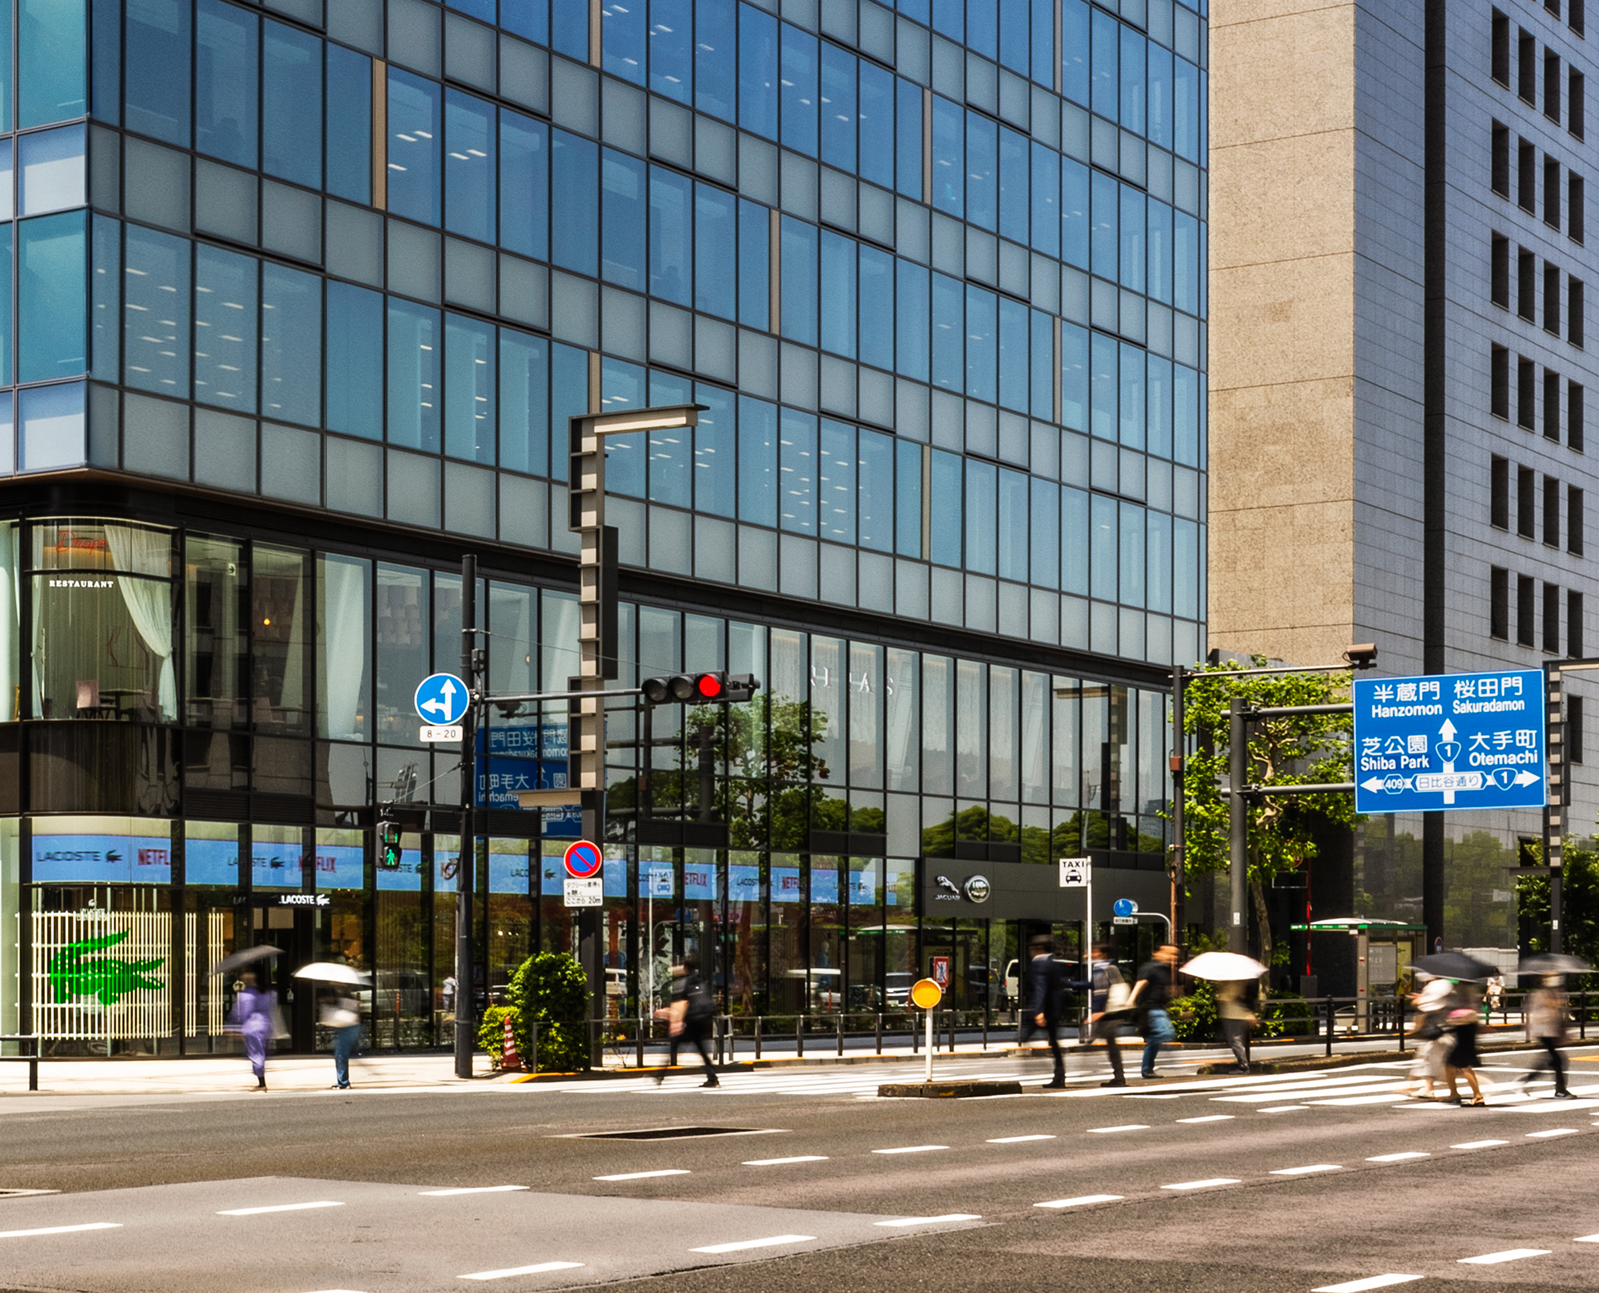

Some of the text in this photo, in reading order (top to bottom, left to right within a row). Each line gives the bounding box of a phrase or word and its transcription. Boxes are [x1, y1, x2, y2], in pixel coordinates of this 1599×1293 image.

[56, 529, 108, 555] Drape
[49, 579, 114, 588] RESTAURANT
[1373, 676, 1523, 703] 半蔵門 桜田門
[1372, 699, 1525, 718] Hanzomon Sakuradamon
[1361, 735, 1428, 756] 芝公園
[1468, 729, 1537, 751] 大手町
[1444, 744, 1451, 757] 1
[1469, 750, 1538, 766] Otemachi
[1360, 755, 1430, 771] Shiba Park
[1385, 778, 1403, 790] 409
[1418, 774, 1479, 789] 日比谷通り
[1501, 771, 1508, 784] 1
[36, 848, 171, 865] LACOSTE NETFL
[227, 855, 337, 873] LASTE NFLIX
[1063, 860, 1085, 868] TAXI
[510, 869, 529, 878] LACO
[684, 872, 708, 887] ETFLIX
[736, 877, 759, 886] LACOST
[281, 895, 314, 905] LACOSTE
[935, 893, 961, 901] JAGUAR
